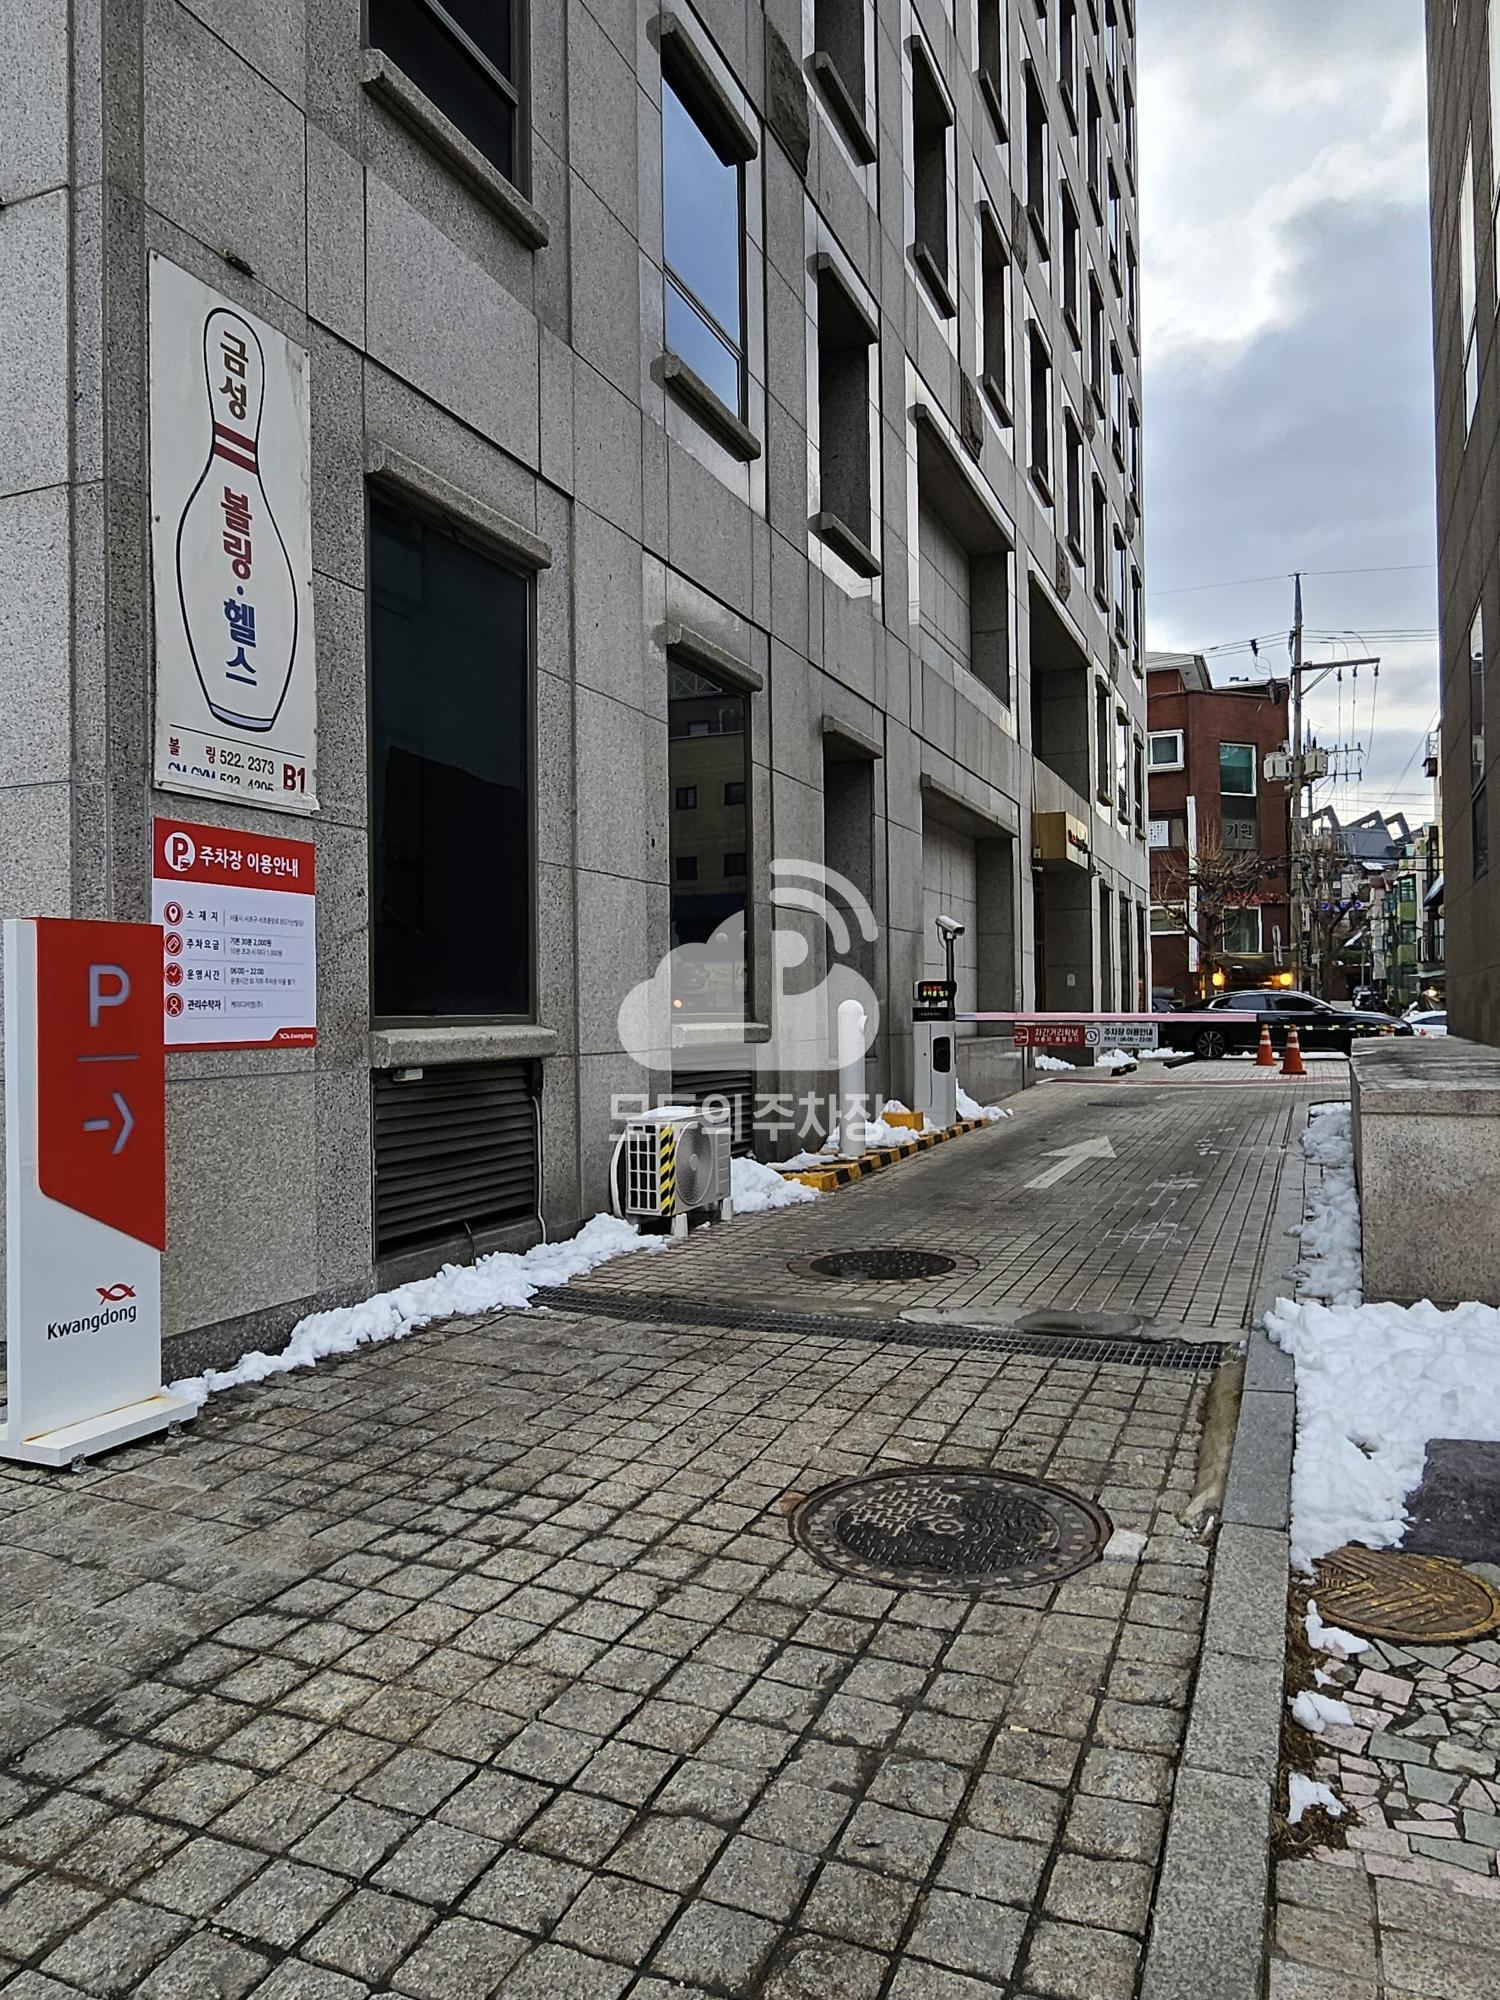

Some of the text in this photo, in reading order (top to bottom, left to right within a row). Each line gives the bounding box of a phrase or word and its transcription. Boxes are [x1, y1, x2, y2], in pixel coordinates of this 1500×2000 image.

[219, 331, 249, 420] 금성
[248, 756, 275, 775] 2373
[283, 763, 306, 793] B1
[1226, 823, 1252, 840] 기원
[199, 845, 299, 878] 주차장 이용안내
[186, 939, 220, 950] 주차요금
[187, 969, 220, 980] 운영시간
[88, 963, 132, 1028] P
[187, 1000, 221, 1011] 관리수탁자
[47, 1305, 137, 1340] Kwangdong
